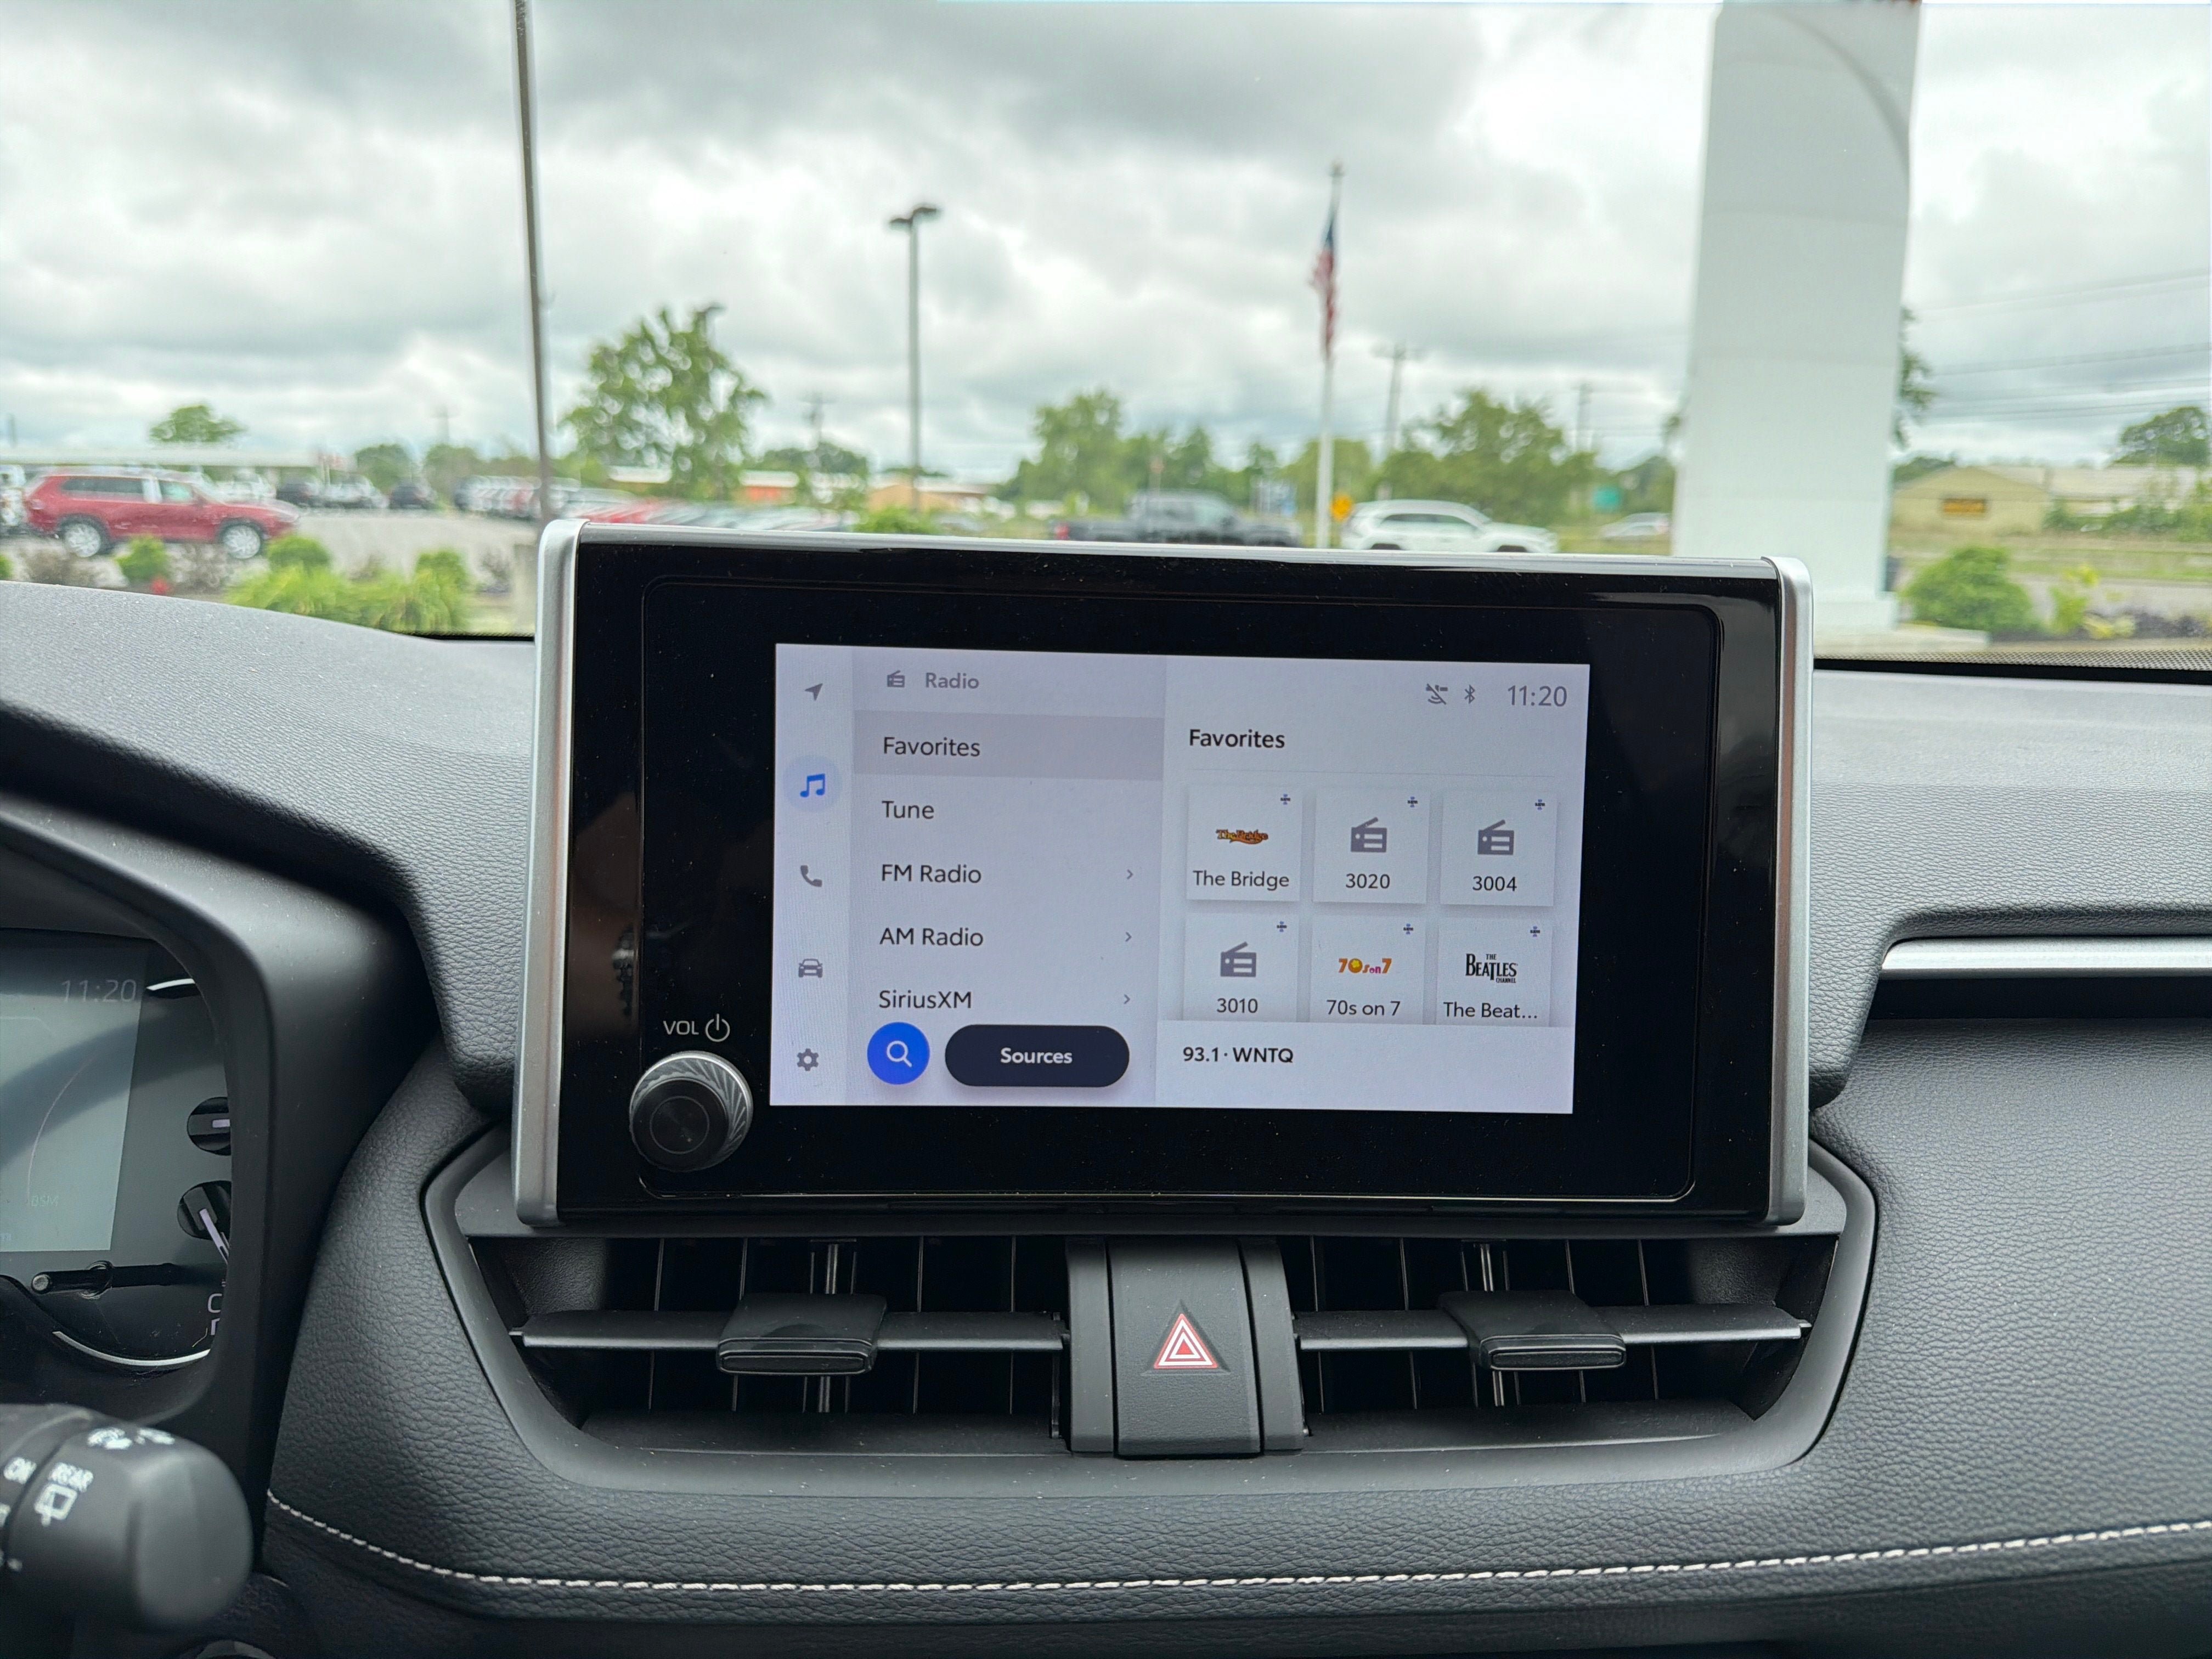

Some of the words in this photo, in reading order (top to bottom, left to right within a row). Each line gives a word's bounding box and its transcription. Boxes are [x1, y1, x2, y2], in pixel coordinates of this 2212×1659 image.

[925, 672, 979, 689] Radio
[1507, 685, 1568, 707] 11:20
[883, 736, 981, 757] Favorites
[1189, 729, 1285, 748] Favorites
[881, 800, 935, 820] Tune
[881, 864, 912, 882] FM
[920, 864, 982, 883] Radio
[1192, 870, 1226, 886] The
[1231, 871, 1290, 891] Bridge
[1345, 873, 1391, 889] 3020
[1471, 876, 1518, 892] 3004
[879, 927, 915, 945] AM
[922, 927, 984, 946] Radio
[61, 979, 137, 1003] 11:20
[879, 989, 972, 1009] SiriusXM
[1216, 997, 1259, 1014] 3010
[1326, 999, 1357, 1015] 70s
[1362, 1005, 1385, 1016] on
[1390, 1000, 1401, 1016] 7
[1443, 1001, 1476, 1018] The
[1481, 1002, 1538, 1019] Beat...
[663, 1020, 699, 1035] VOL
[1000, 1047, 1073, 1064] Sources
[1232, 1047, 1294, 1064] WNTQ
